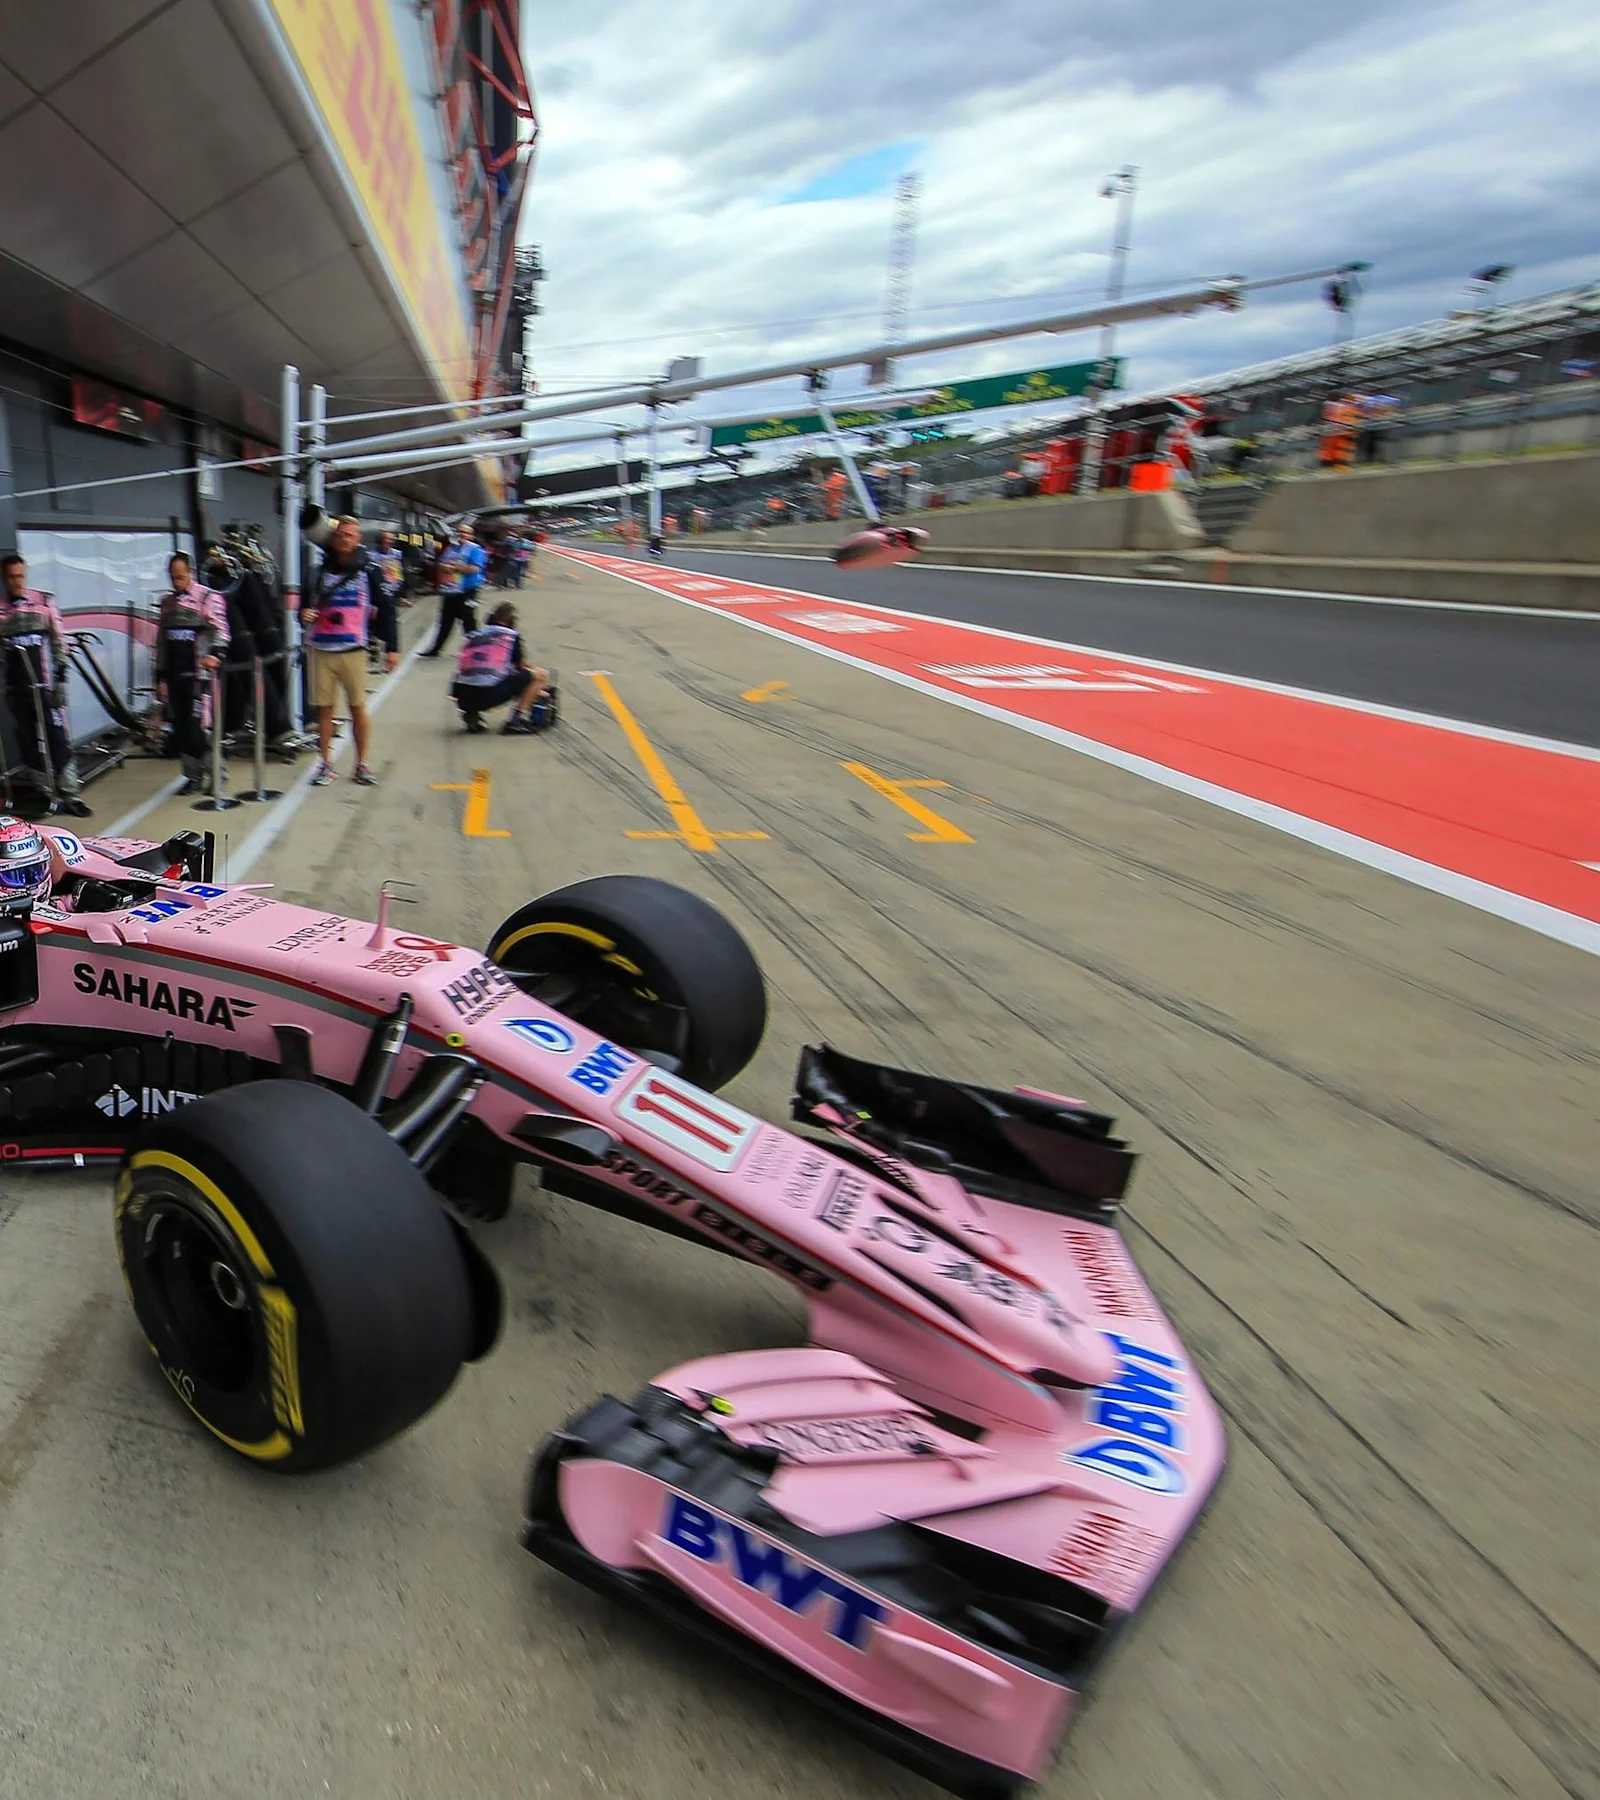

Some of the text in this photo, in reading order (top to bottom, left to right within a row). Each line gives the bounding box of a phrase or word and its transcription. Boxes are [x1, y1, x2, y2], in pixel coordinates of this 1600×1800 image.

[17, 839, 38, 852] BWT
[66, 853, 88, 866] BWT
[72, 962, 237, 1033] SAHARA
[441, 959, 513, 1015] HYPE
[565, 1040, 640, 1096] BWT
[635, 1077, 746, 1154] 11
[600, 1149, 697, 1205] SPORT
[1090, 1329, 1186, 1454] BWT
[663, 1492, 892, 1656] BWT
